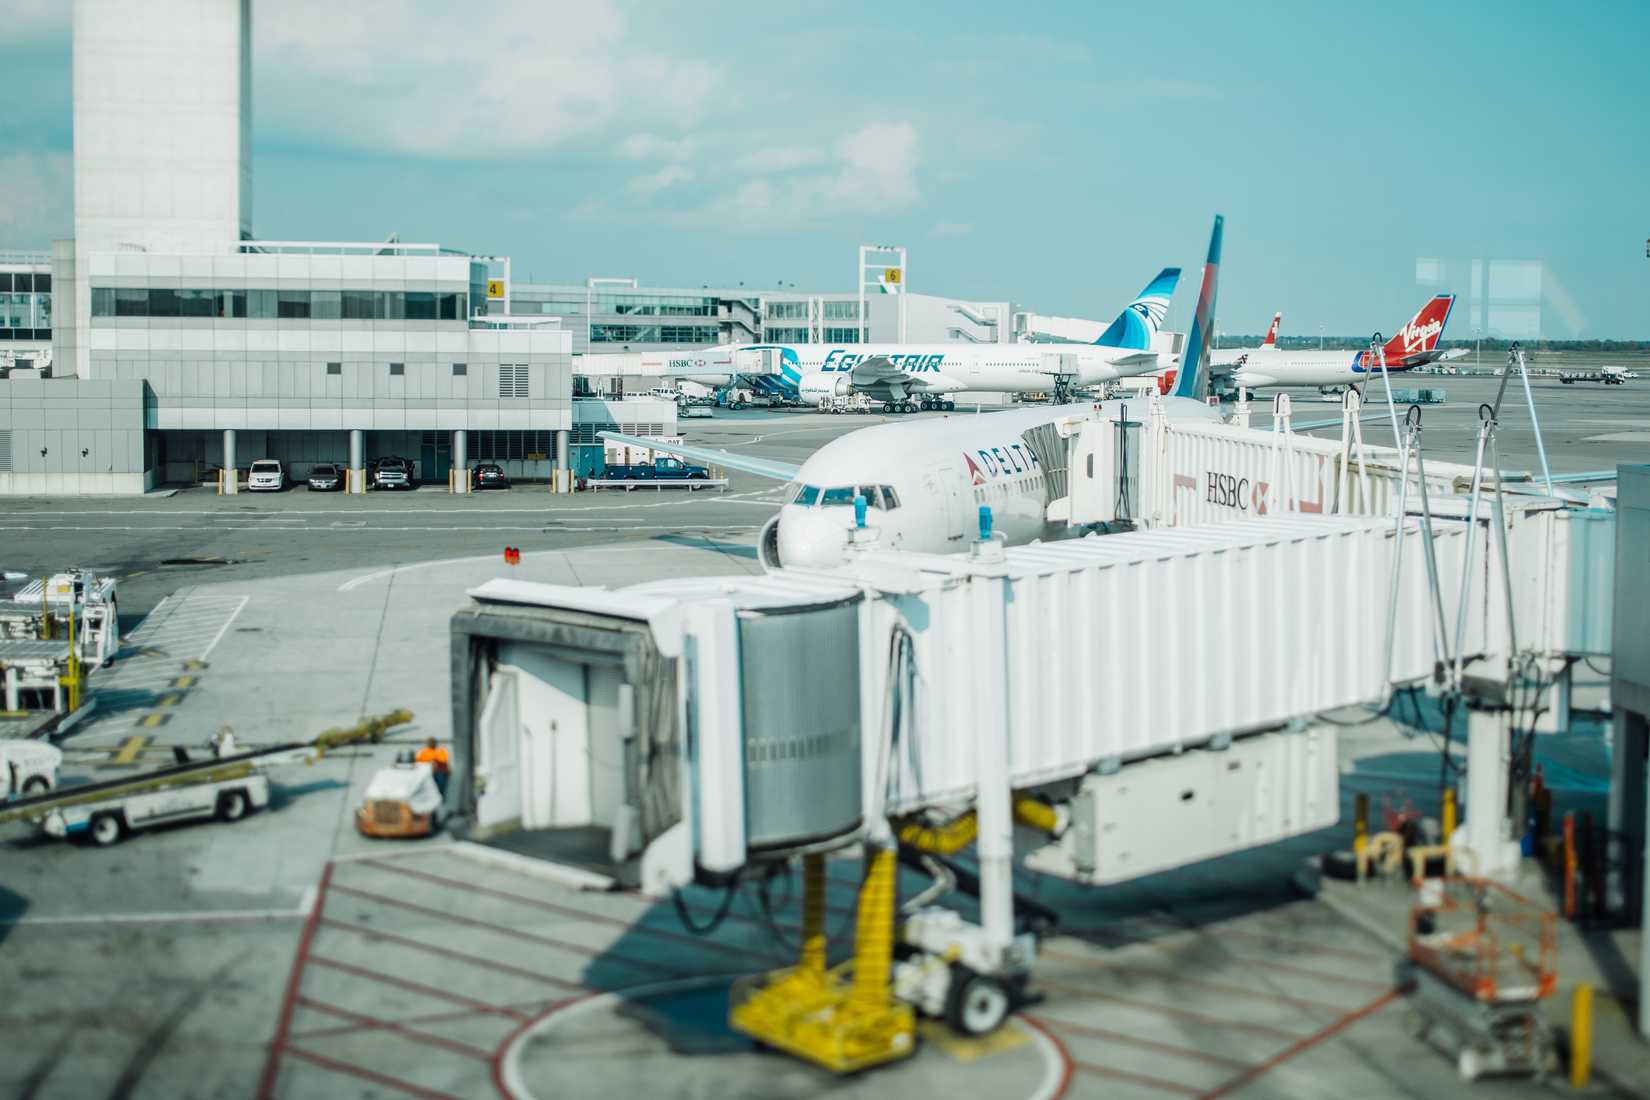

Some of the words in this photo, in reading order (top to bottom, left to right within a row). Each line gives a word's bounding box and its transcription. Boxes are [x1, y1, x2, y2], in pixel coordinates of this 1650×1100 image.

[890, 270, 897, 281] 6
[489, 283, 497, 294] 4
[1399, 317, 1442, 352] Virgin
[668, 359, 694, 368] HSBC
[820, 349, 945, 373] EGTAIR
[977, 443, 1038, 478] DELTA
[1206, 471, 1249, 511] HSBC
